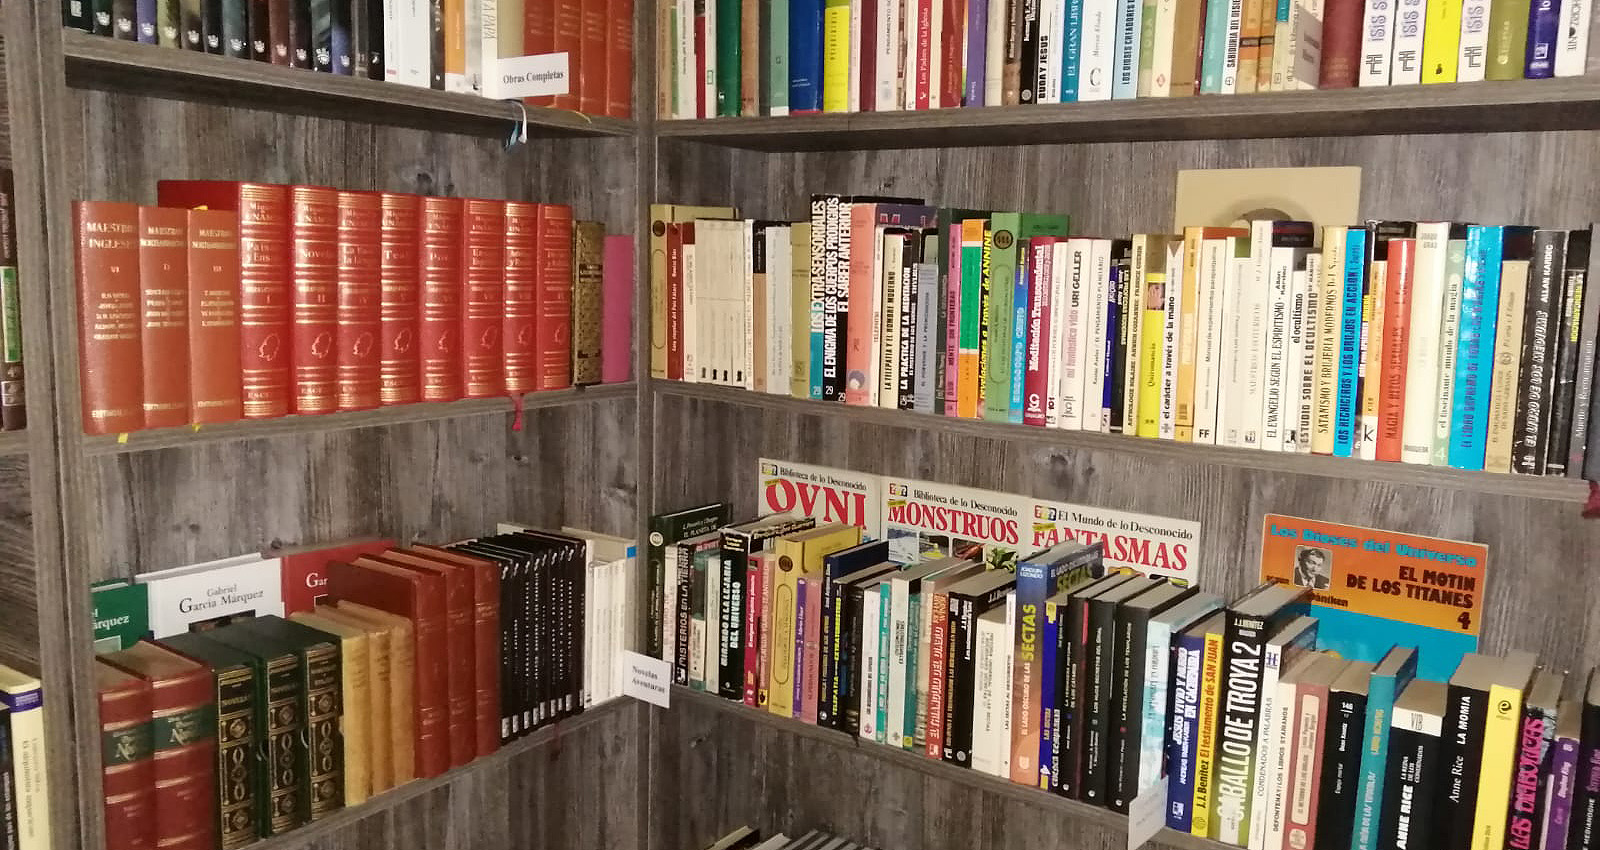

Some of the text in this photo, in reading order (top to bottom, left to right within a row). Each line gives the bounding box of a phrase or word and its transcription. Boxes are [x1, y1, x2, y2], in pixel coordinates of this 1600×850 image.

[1040, 35, 1048, 64] JESUS
[503, 71, 564, 84] Obras Completas
[826, 197, 839, 250] PRODIGIOS
[839, 203, 851, 259] ANTERIOR
[826, 252, 838, 294] CUERPOS
[839, 261, 851, 298] SABER
[1073, 251, 1082, 289] GELLER
[825, 297, 837, 313] LOS
[1072, 290, 1080, 308] URI
[1448, 284, 1458, 310] magia
[1541, 278, 1550, 303] ALLAN
[811, 312, 824, 332] LOS
[1272, 302, 1284, 349] ESPIRITISMO
[1292, 293, 1303, 335] ocultismo
[825, 328, 836, 365] ENIGMA
[1534, 310, 1548, 363] MEDIUMS
[1165, 345, 1173, 368] través
[1301, 369, 1312, 400] SOBRE
[1531, 365, 1542, 384] LOS
[1267, 389, 1279, 427] EVANGELIO
[1529, 386, 1540, 400] DE
[1300, 404, 1310, 443] ESTUDIO
[1318, 388, 1330, 434] SATANISMO
[1526, 402, 1539, 432] LIBRO
[780, 467, 809, 479] Biblioteca
[827, 476, 867, 491] Desconocido
[766, 479, 866, 530] OVNI
[913, 489, 947, 504] Biblioteca
[970, 499, 1018, 517] Desconocido
[887, 501, 1019, 545] MONSTRUOS
[1072, 512, 1104, 529] Mundo
[1131, 522, 1193, 540] Desconocido
[1032, 527, 1188, 571] FANTASMAS
[1271, 524, 1477, 567] Los Dioses del Universo
[206, 584, 237, 598] Gabriel
[723, 560, 732, 600] LEJANIA
[1346, 574, 1473, 609] DE LOS TITANES
[1399, 565, 1475, 591] EL MOTIN
[179, 590, 264, 614] García Márquez
[730, 581, 741, 648] DEL UNIVERSO
[1022, 604, 1036, 661] SECTAS
[1456, 611, 1471, 630] 4
[1207, 640, 1218, 663] JUAN
[632, 665, 658, 680] Novelas
[1205, 665, 1216, 683] SAN
[1200, 698, 1213, 747] testamento
[1458, 696, 1471, 730] MOMIA
[1217, 642, 1261, 821] CABALLO DE TROYA 2
[1196, 759, 1209, 794] Benítez
[1451, 755, 1464, 776] Rice
[1448, 778, 1461, 802] Anne
[1396, 785, 1413, 850] ANNE RICE
[1510, 816, 1532, 849] LAS
